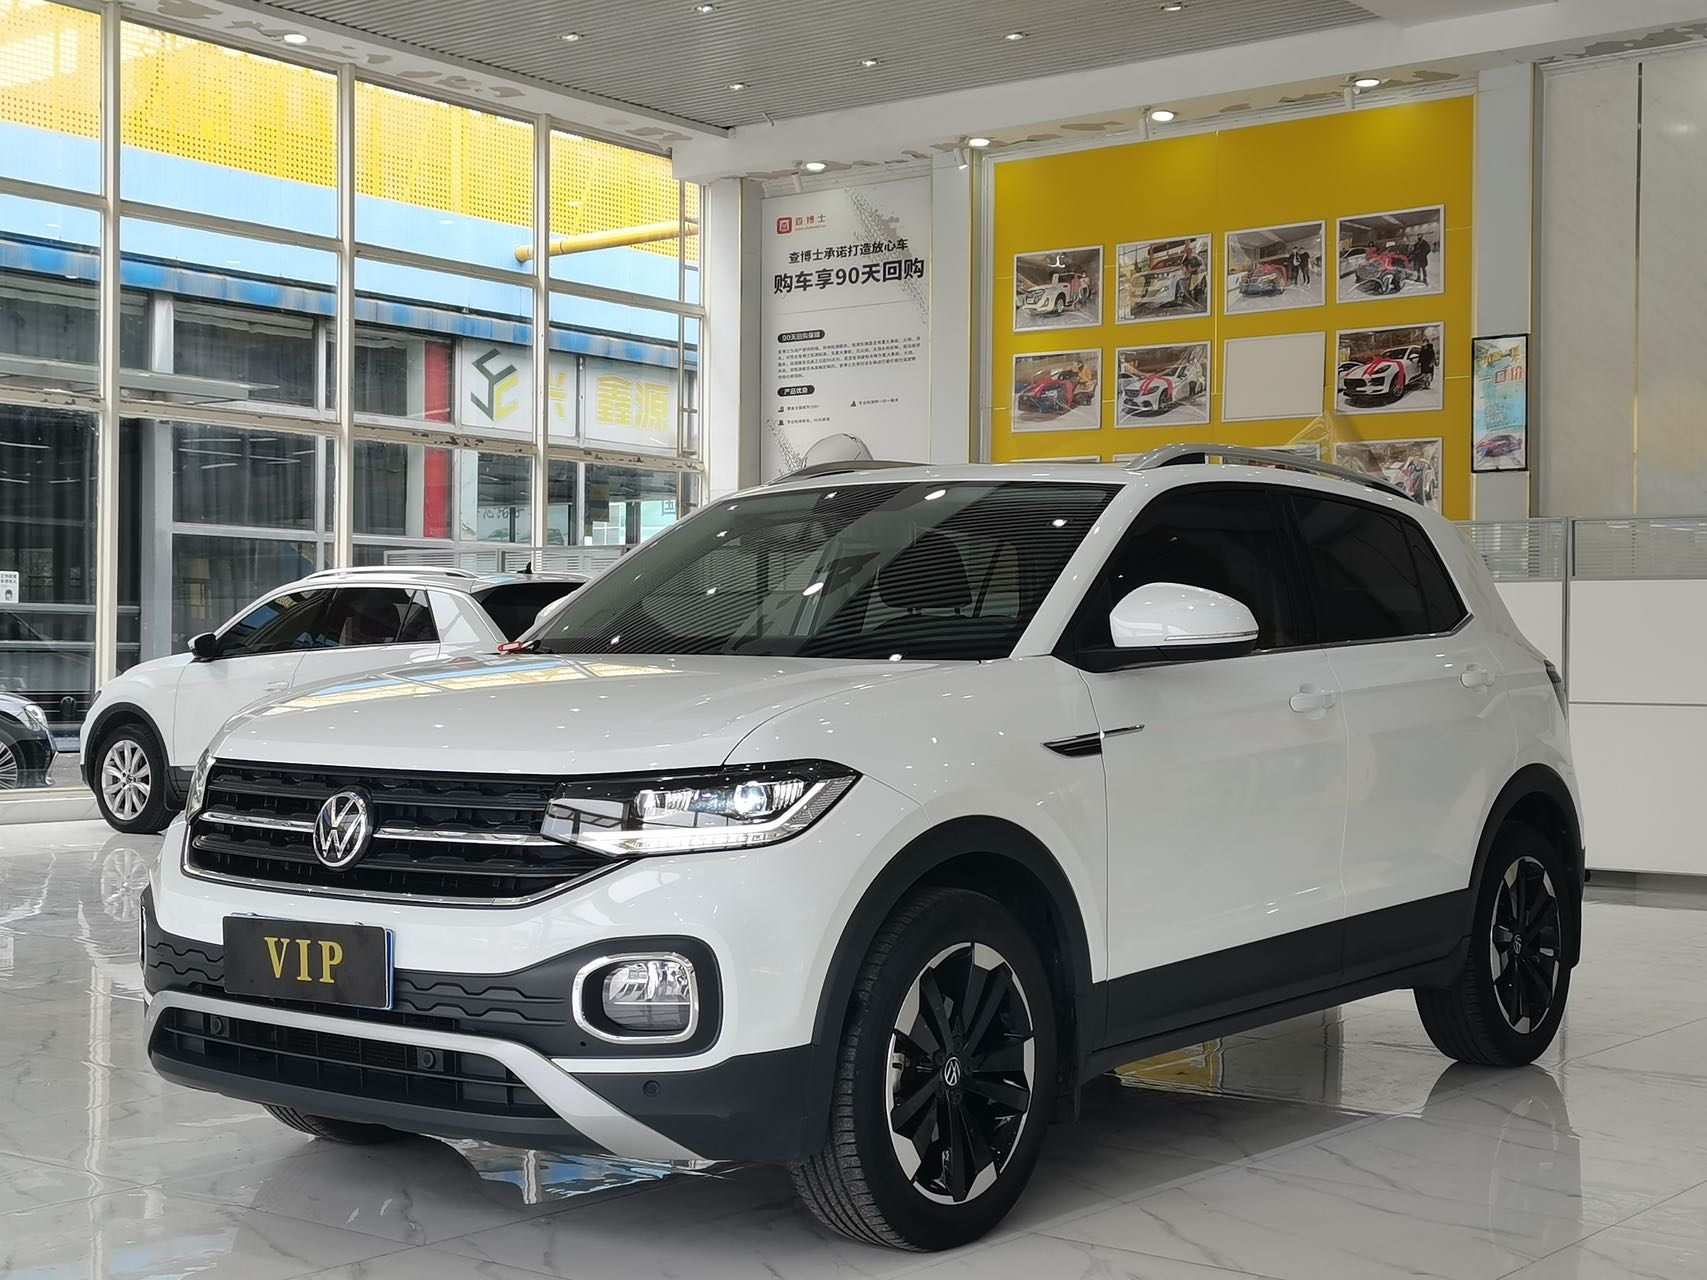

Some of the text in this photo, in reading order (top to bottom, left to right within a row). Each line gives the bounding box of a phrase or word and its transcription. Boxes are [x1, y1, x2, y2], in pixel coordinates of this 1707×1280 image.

[788, 238, 909, 264] 查博士承诺打造放心车
[774, 257, 925, 294] 购车享90天回购
[264, 936, 344, 984] VIP
